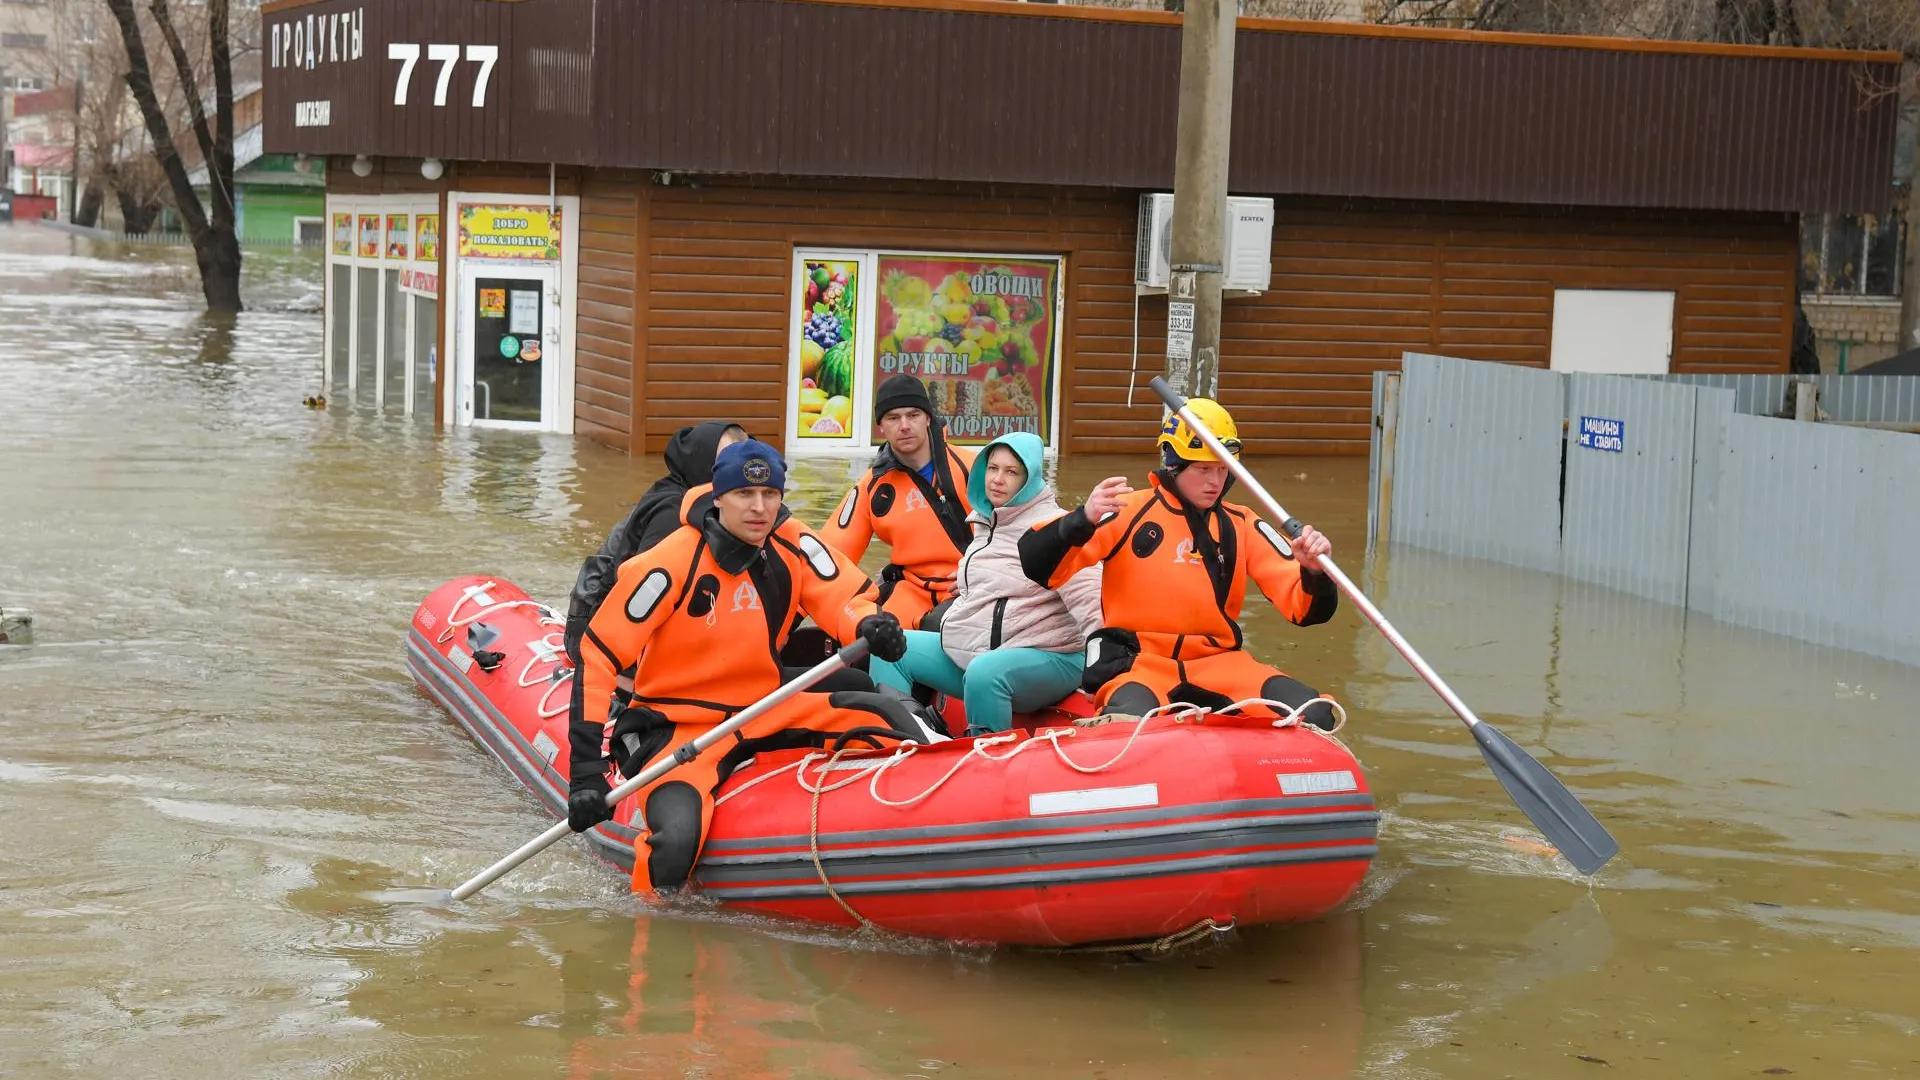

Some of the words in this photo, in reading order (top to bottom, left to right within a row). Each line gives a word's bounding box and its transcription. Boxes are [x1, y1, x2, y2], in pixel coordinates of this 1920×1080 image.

[271, 7, 363, 70] ПРОДУКТЫ
[388, 43, 498, 108] 777
[295, 100, 330, 127] МАГАЗИН
[493, 218, 528, 230] ДОБРО
[473, 235, 548, 247] ПОЖАЛОВАТЬ!
[970, 274, 1043, 299] ОВОЩИ
[879, 352, 969, 375] ФРУКТЫ
[937, 415, 1039, 437] ХОФРУКТЫ
[1585, 419, 1619, 435] МАШИНЫ
[1580, 433, 1590, 445] НЕ
[1594, 436, 1621, 450] СТАВИТЬ
